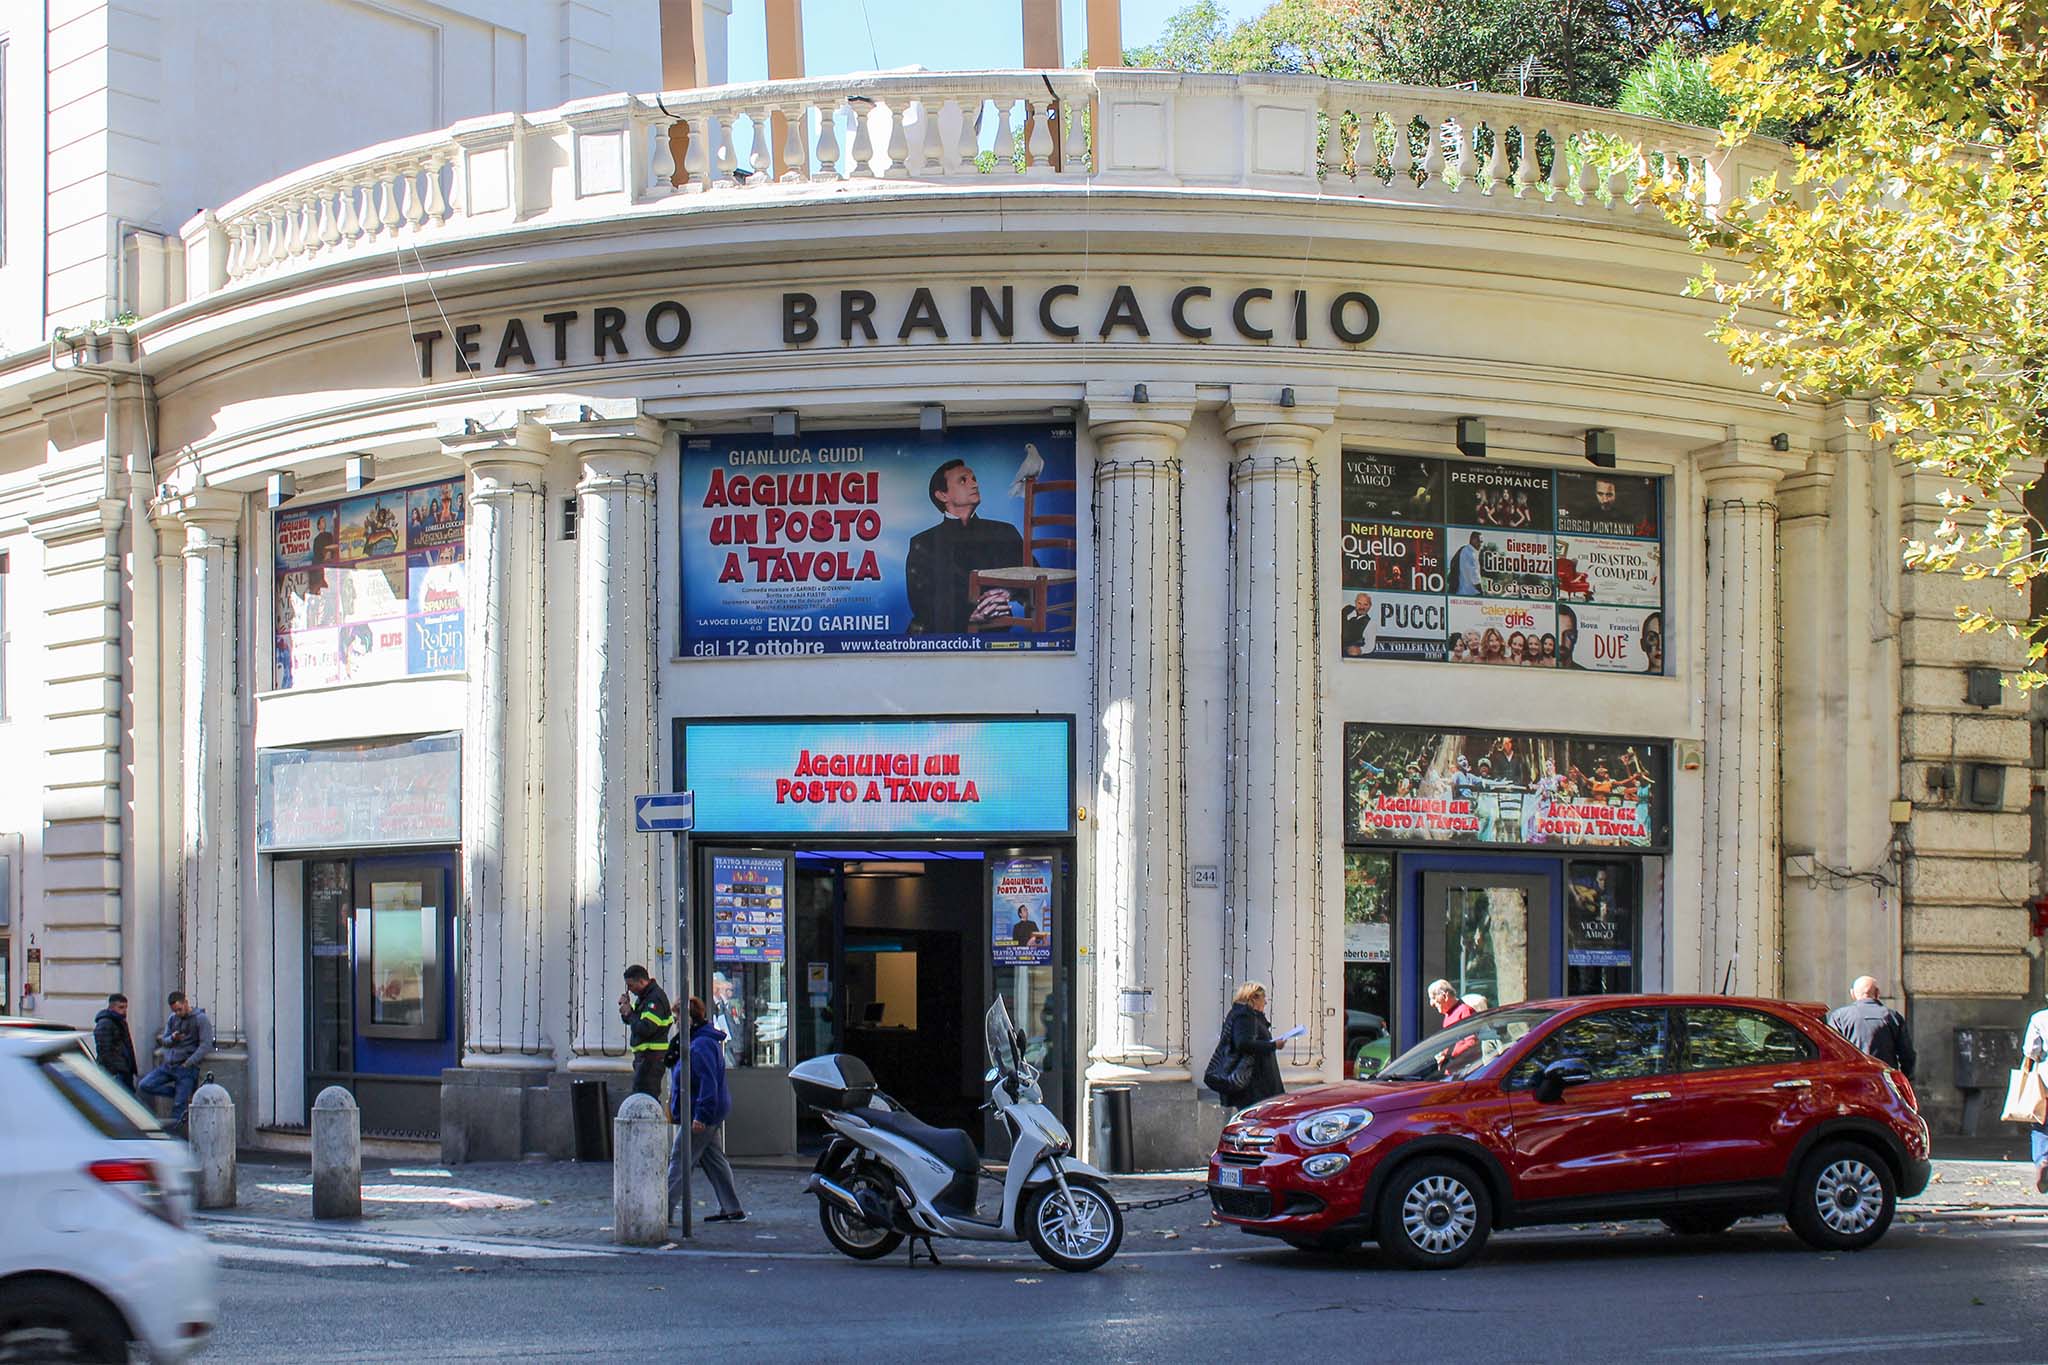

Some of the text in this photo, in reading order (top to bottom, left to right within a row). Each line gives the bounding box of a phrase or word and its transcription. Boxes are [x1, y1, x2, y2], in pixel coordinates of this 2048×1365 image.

[413, 284, 1382, 379] TEATRO BRANCACCIO
[729, 447, 864, 467] GIANLUCA GUIDI
[1347, 462, 1397, 475] VICENTE
[703, 468, 879, 508] AGGIUNGI
[1353, 474, 1391, 487] AMIGO
[1452, 472, 1549, 489] PERFORMANCE
[709, 508, 881, 546] UN POSTO
[1351, 523, 1434, 540] Neri Marcorè
[1558, 518, 1635, 536] GIORGIO MONTANINI
[1342, 534, 1406, 558] Quello
[1506, 538, 1548, 555] Giuseppe
[718, 546, 881, 584] A TAVOLA
[1350, 558, 1377, 571] non
[1418, 555, 1438, 567] che
[1484, 551, 1552, 574] Giacobazzi
[1590, 552, 1641, 567] DISASTRO
[1411, 566, 1445, 592] ho
[1505, 581, 1517, 593] ci
[1521, 582, 1551, 595] sarò
[709, 618, 729, 626] VOCE
[768, 615, 890, 632] ENZO GARINEI
[1380, 603, 1445, 630] PUCCI
[1505, 611, 1534, 628] girls
[416, 621, 463, 650] Robin
[1609, 623, 1640, 632] Francini
[693, 638, 825, 656] dal 12 ottobre
[841, 637, 981, 651] www.teatrobrancaccio.it
[1375, 642, 1446, 653] IN TOLLERANZA
[794, 749, 961, 778] AGGIUNGI UN
[775, 776, 980, 804] POSTO A TAVOLA
[1376, 793, 1470, 816] AGGIUNGI UN
[1547, 801, 1615, 822] AGGIUNGI
[1364, 812, 1480, 832] POSTO A TAVOLA
[1537, 819, 1647, 838] POSTO A TAVOLA
[1196, 871, 1215, 882] 244
[996, 885, 1049, 895] POSTO A TAVOLA
[1584, 930, 1614, 940] AMIGO
